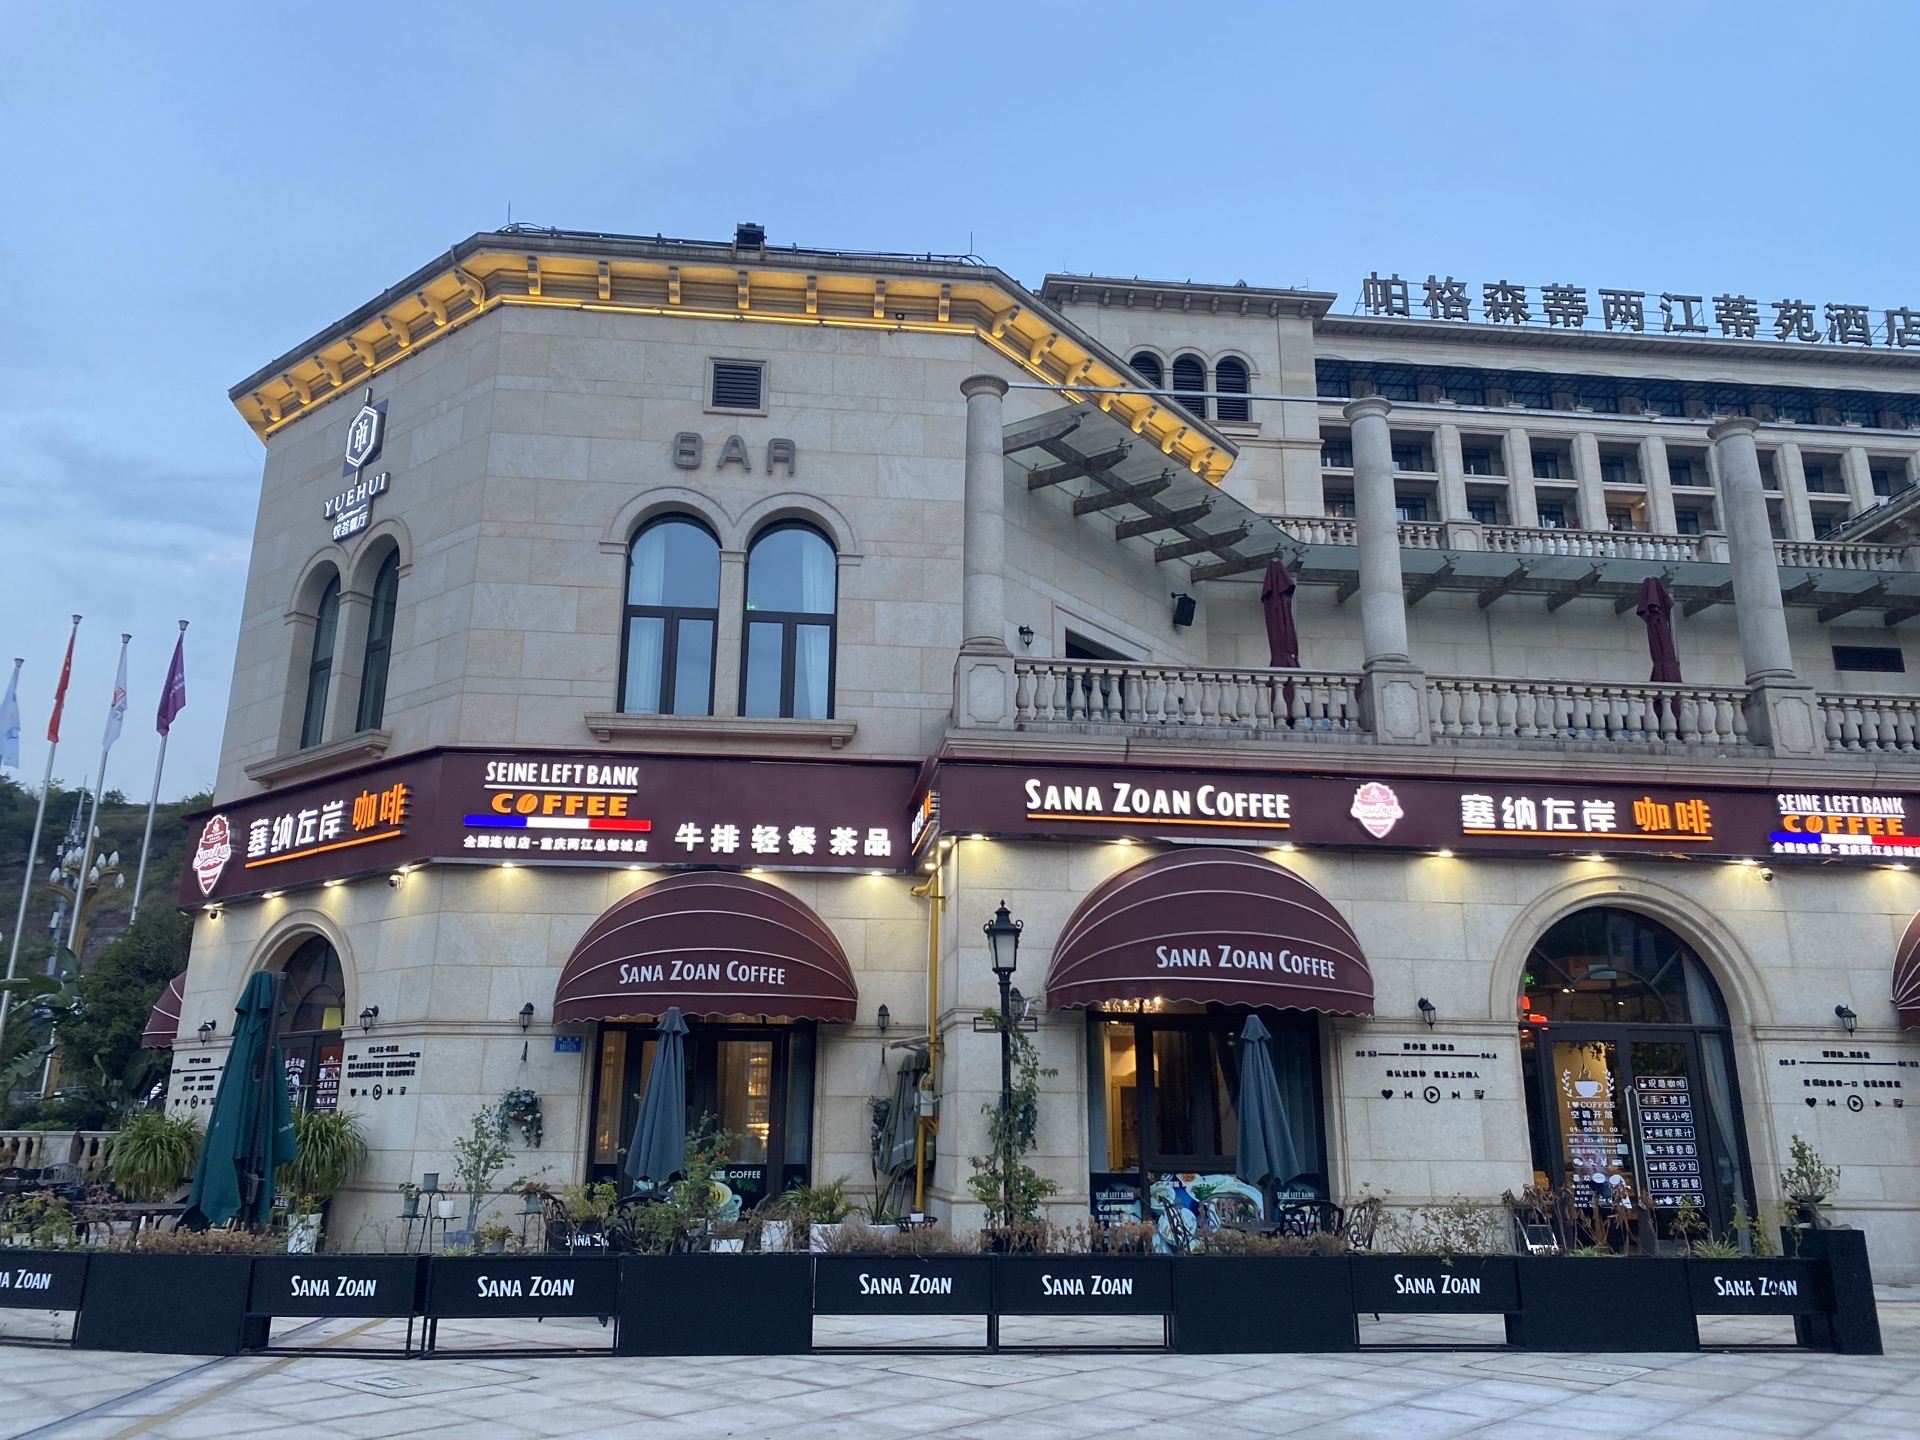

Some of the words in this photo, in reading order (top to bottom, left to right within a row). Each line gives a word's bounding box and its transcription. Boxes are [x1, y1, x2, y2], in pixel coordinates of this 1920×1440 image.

[673, 432, 796, 475] BAR
[324, 472, 386, 517] YUEHUI
[485, 761, 538, 783] SEINE
[540, 763, 584, 784] LEFT
[586, 765, 639, 786] BANK
[492, 793, 628, 817] COFFEE
[1025, 779, 1103, 811] SANA
[1112, 783, 1191, 815] ZOAN
[1197, 785, 1290, 819] COFFEE
[1777, 794, 1821, 811] SEINE
[1824, 795, 1859, 812] LEFT
[1862, 796, 1905, 814] BANK
[1783, 814, 1904, 835] COFFEE
[619, 964, 664, 984] SANA
[669, 960, 720, 981] ZOAN
[726, 960, 786, 985] COFFEE
[1156, 945, 1211, 968] SANA
[1218, 945, 1273, 970] ZOAN
[1279, 950, 1336, 980] COFFEE
[1571, 1110, 1613, 1119] 空调开放
[1580, 1101, 1615, 1109] COFFEE
[1652, 1112, 1690, 1121] 美味小吃
[729, 1170, 761, 1179] COFFEE
[1658, 1162, 1697, 1172] 精品沙拉
[14, 1269, 52, 1290] ZOAN
[290, 1276, 330, 1297] SANA
[336, 1276, 377, 1298] ZOAN
[478, 1276, 522, 1298] SANA
[529, 1276, 575, 1297] ZOAN
[859, 1273, 902, 1295] SANA
[909, 1274, 952, 1295] ZOAN
[1041, 1274, 1085, 1296] SANA
[1091, 1275, 1133, 1295] ZOAN
[1394, 1274, 1435, 1295] SANA
[1441, 1275, 1481, 1295] ZOAN
[1714, 1276, 1755, 1296] SANA
